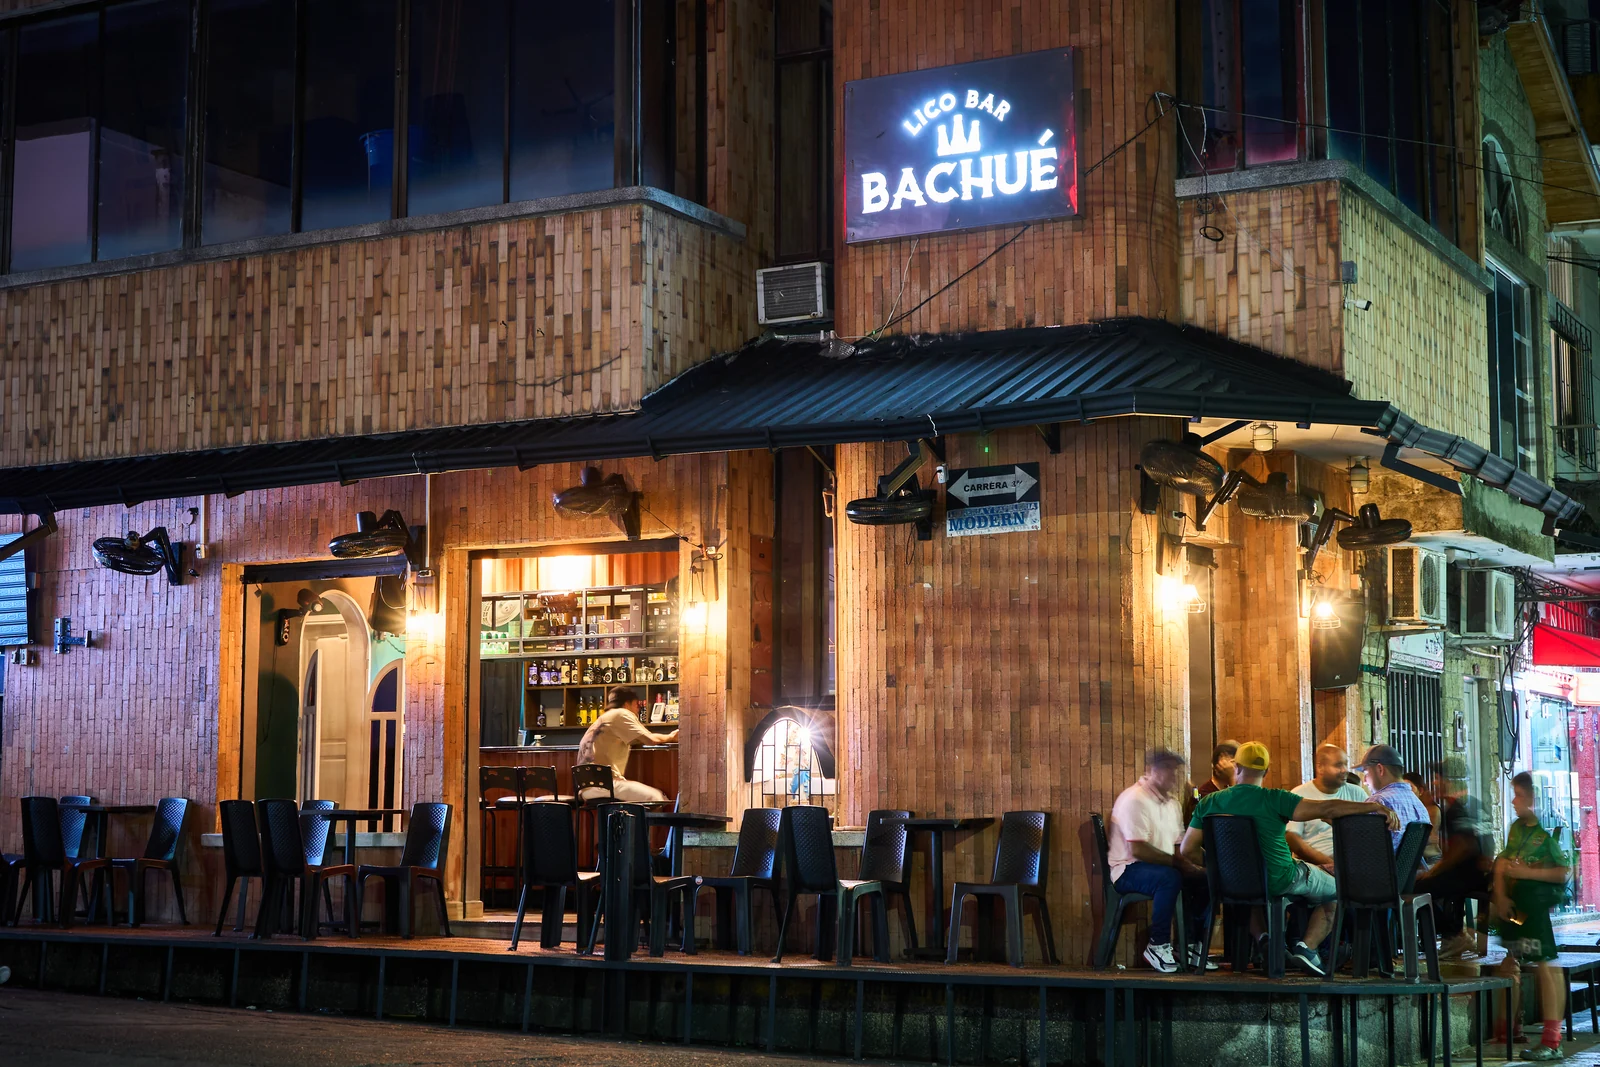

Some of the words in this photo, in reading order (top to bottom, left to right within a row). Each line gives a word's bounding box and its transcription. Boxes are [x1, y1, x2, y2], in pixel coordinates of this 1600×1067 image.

[903, 93, 956, 136] LICO
[965, 90, 1011, 121] BAR
[861, 128, 1058, 214] BACHUÉ
[963, 482, 1008, 492] CARRERA
[948, 511, 1025, 531] MODERN
